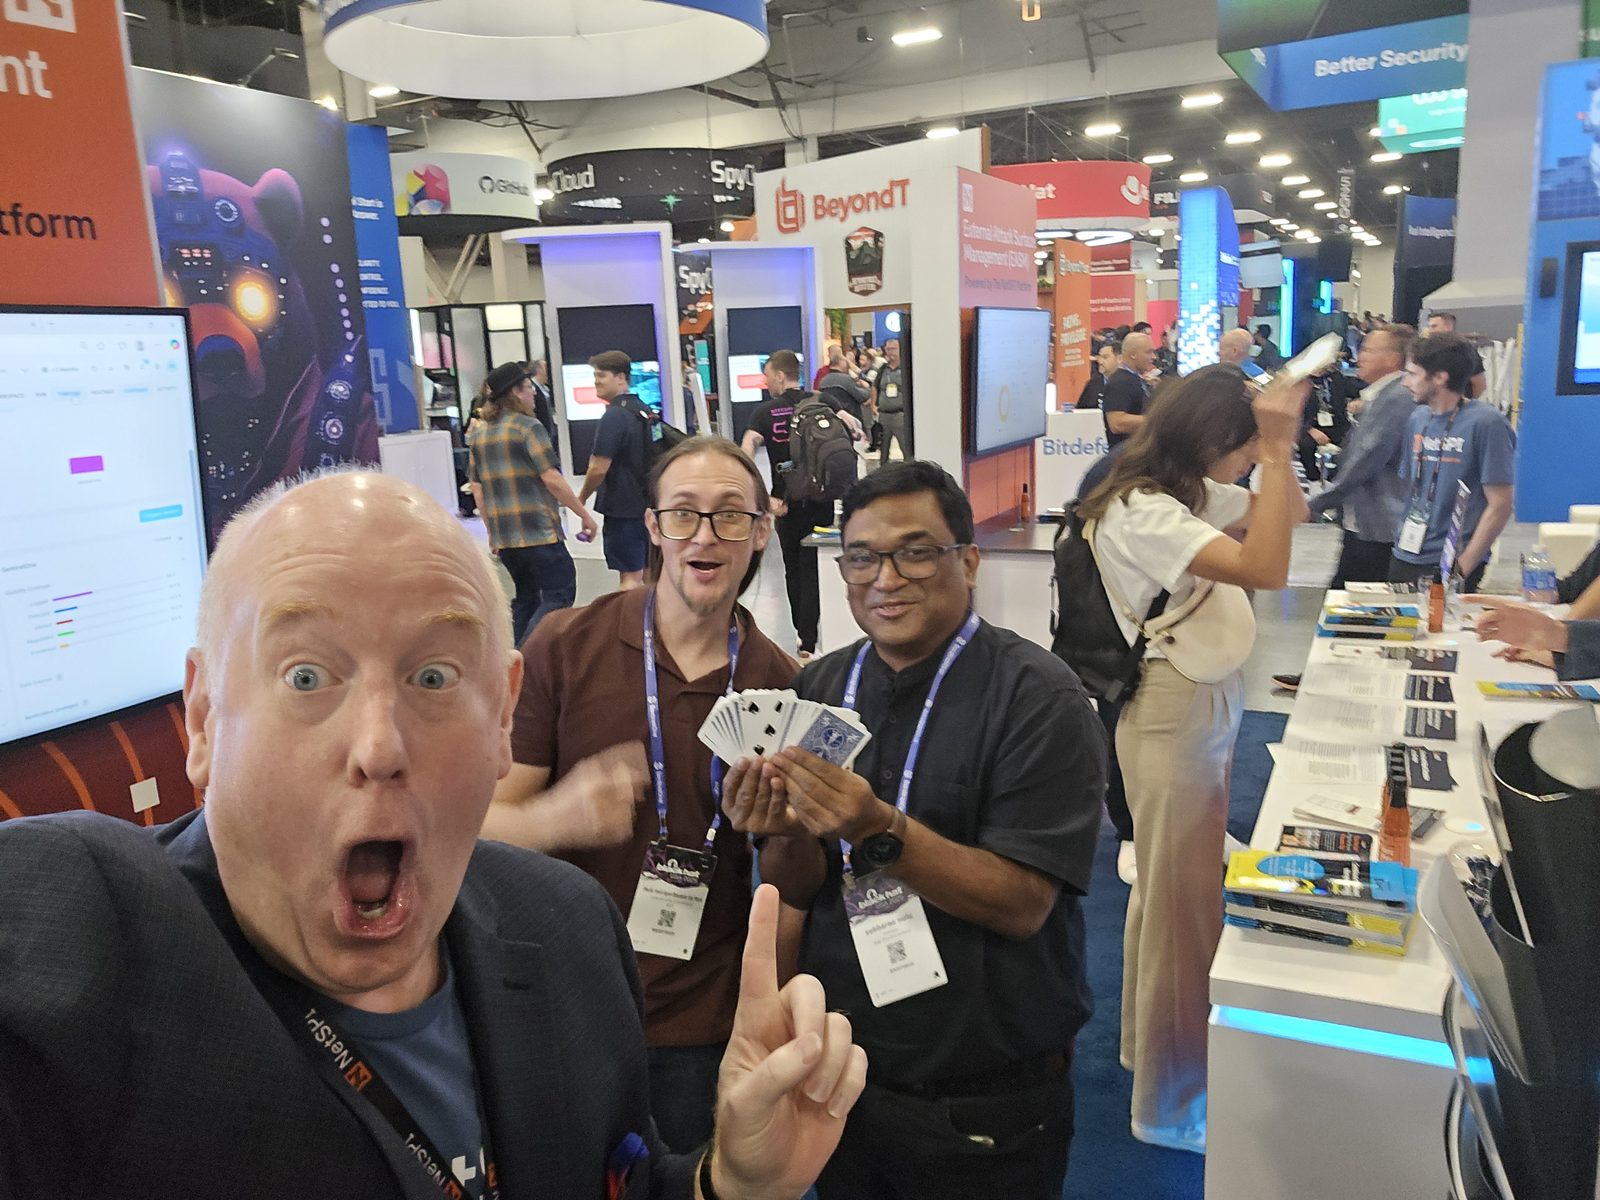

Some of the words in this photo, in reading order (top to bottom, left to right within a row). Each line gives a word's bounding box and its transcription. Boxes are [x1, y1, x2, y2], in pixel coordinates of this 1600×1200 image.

[1314, 56, 1377, 77] Better
[1379, 42, 1468, 68] Security
[813, 178, 911, 223] BeyondT
